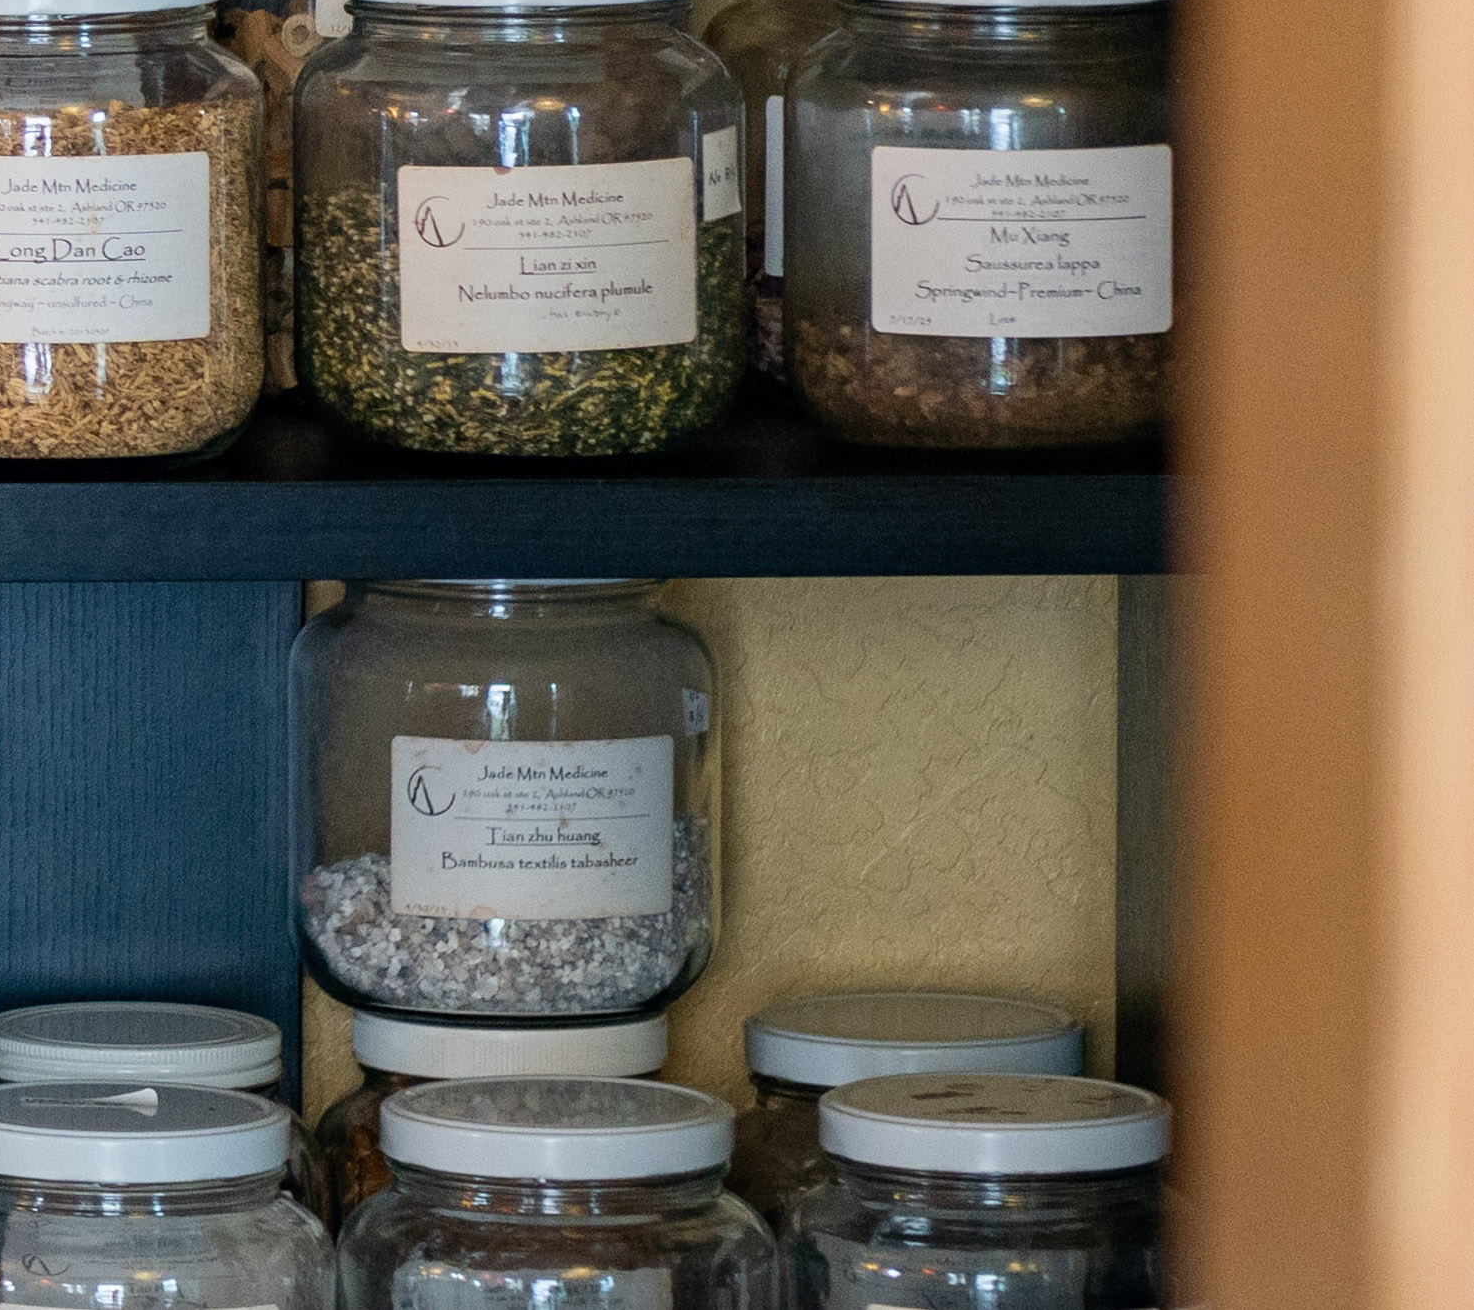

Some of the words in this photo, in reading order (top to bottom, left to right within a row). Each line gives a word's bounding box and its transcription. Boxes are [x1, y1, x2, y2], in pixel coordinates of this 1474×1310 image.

[53, 239, 97, 257] Dan
[101, 239, 145, 258] Cao
[520, 256, 555, 272] Lian
[576, 258, 596, 271] xin
